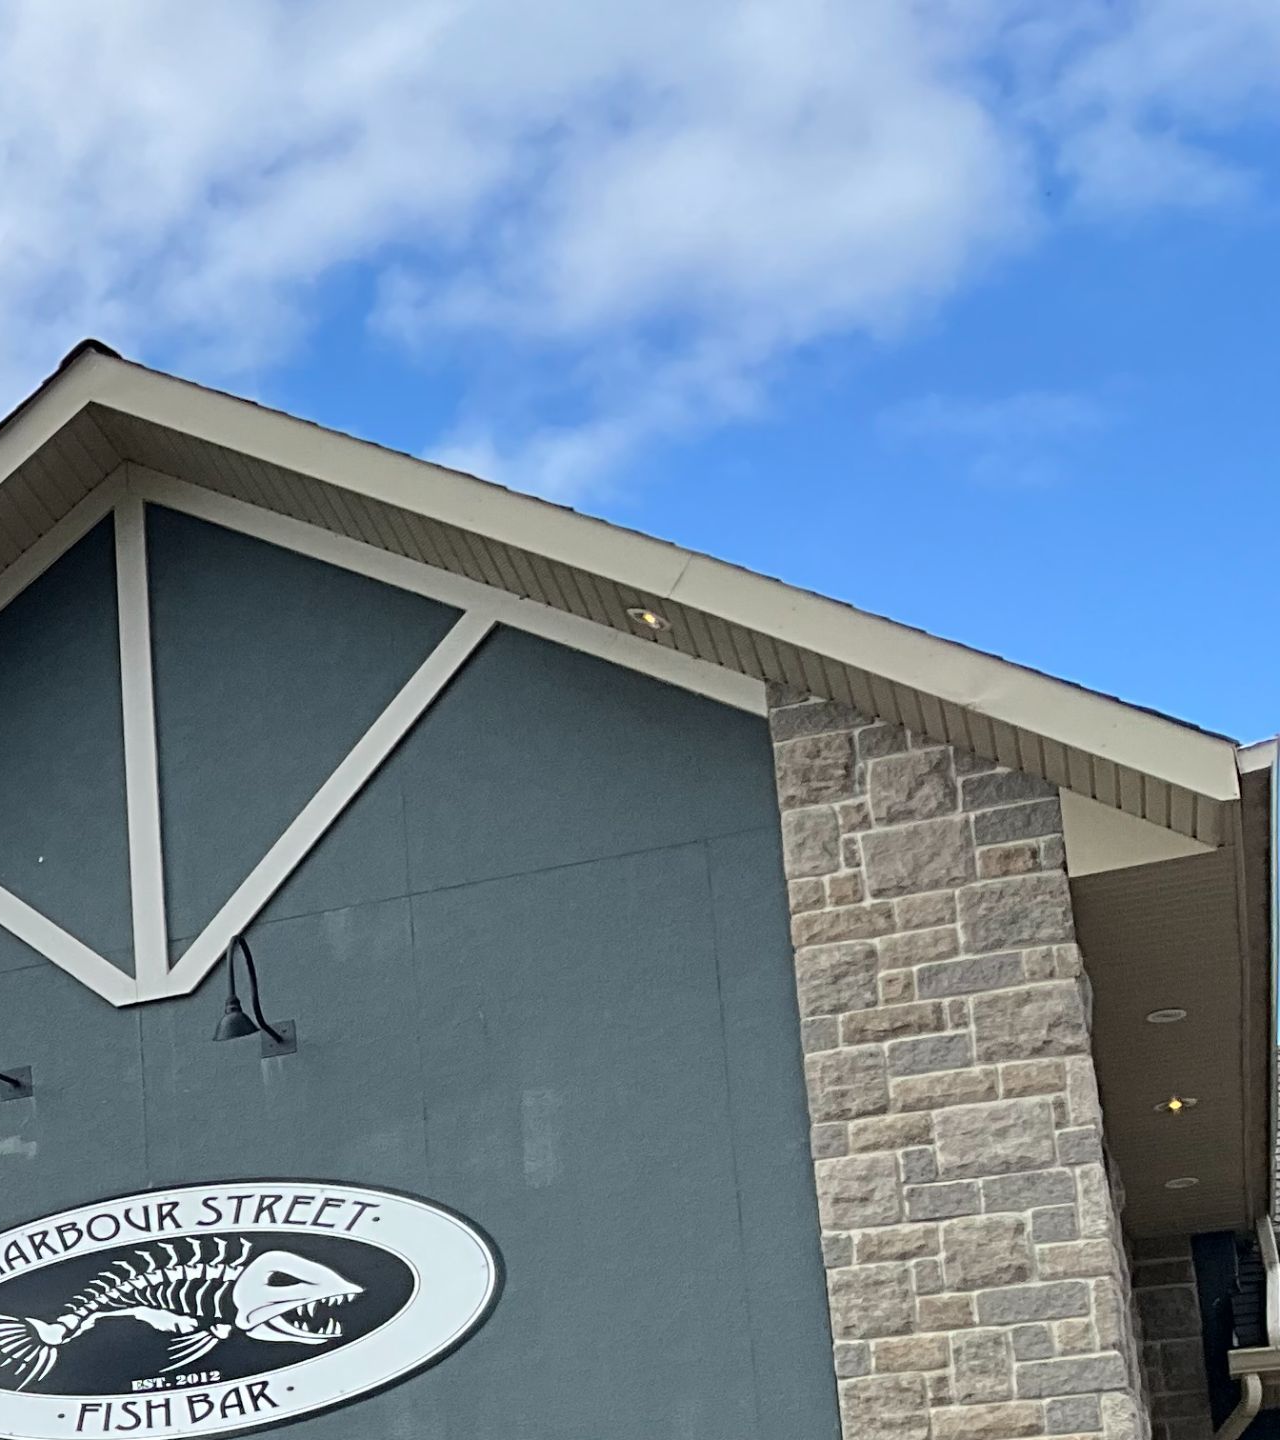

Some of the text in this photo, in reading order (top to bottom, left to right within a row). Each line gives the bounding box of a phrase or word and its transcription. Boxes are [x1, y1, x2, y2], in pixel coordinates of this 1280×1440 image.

[197, 1193, 380, 1233] STREET
[131, 1370, 221, 1392] EST. 2012
[75, 1380, 280, 1432] FISH BAR
